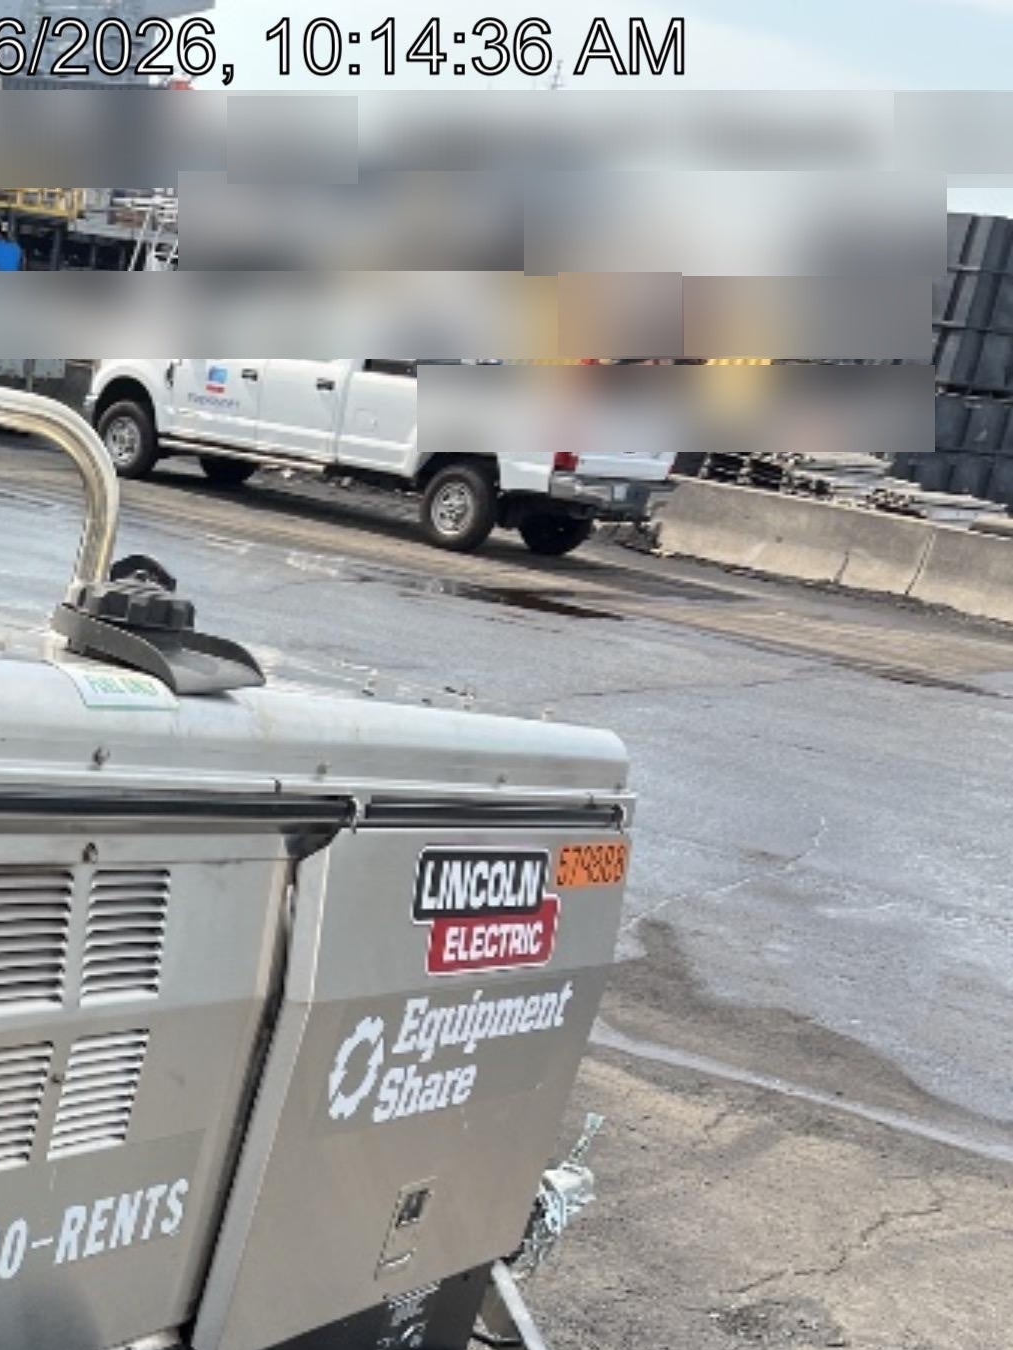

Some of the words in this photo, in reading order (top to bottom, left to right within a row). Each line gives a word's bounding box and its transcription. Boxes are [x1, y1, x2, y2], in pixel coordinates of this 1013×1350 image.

[421, 860, 544, 911] LINCOLN
[442, 920, 544, 964] ELECTRIC
[391, 980, 574, 1063] Equipment
[372, 1064, 477, 1123] Share
